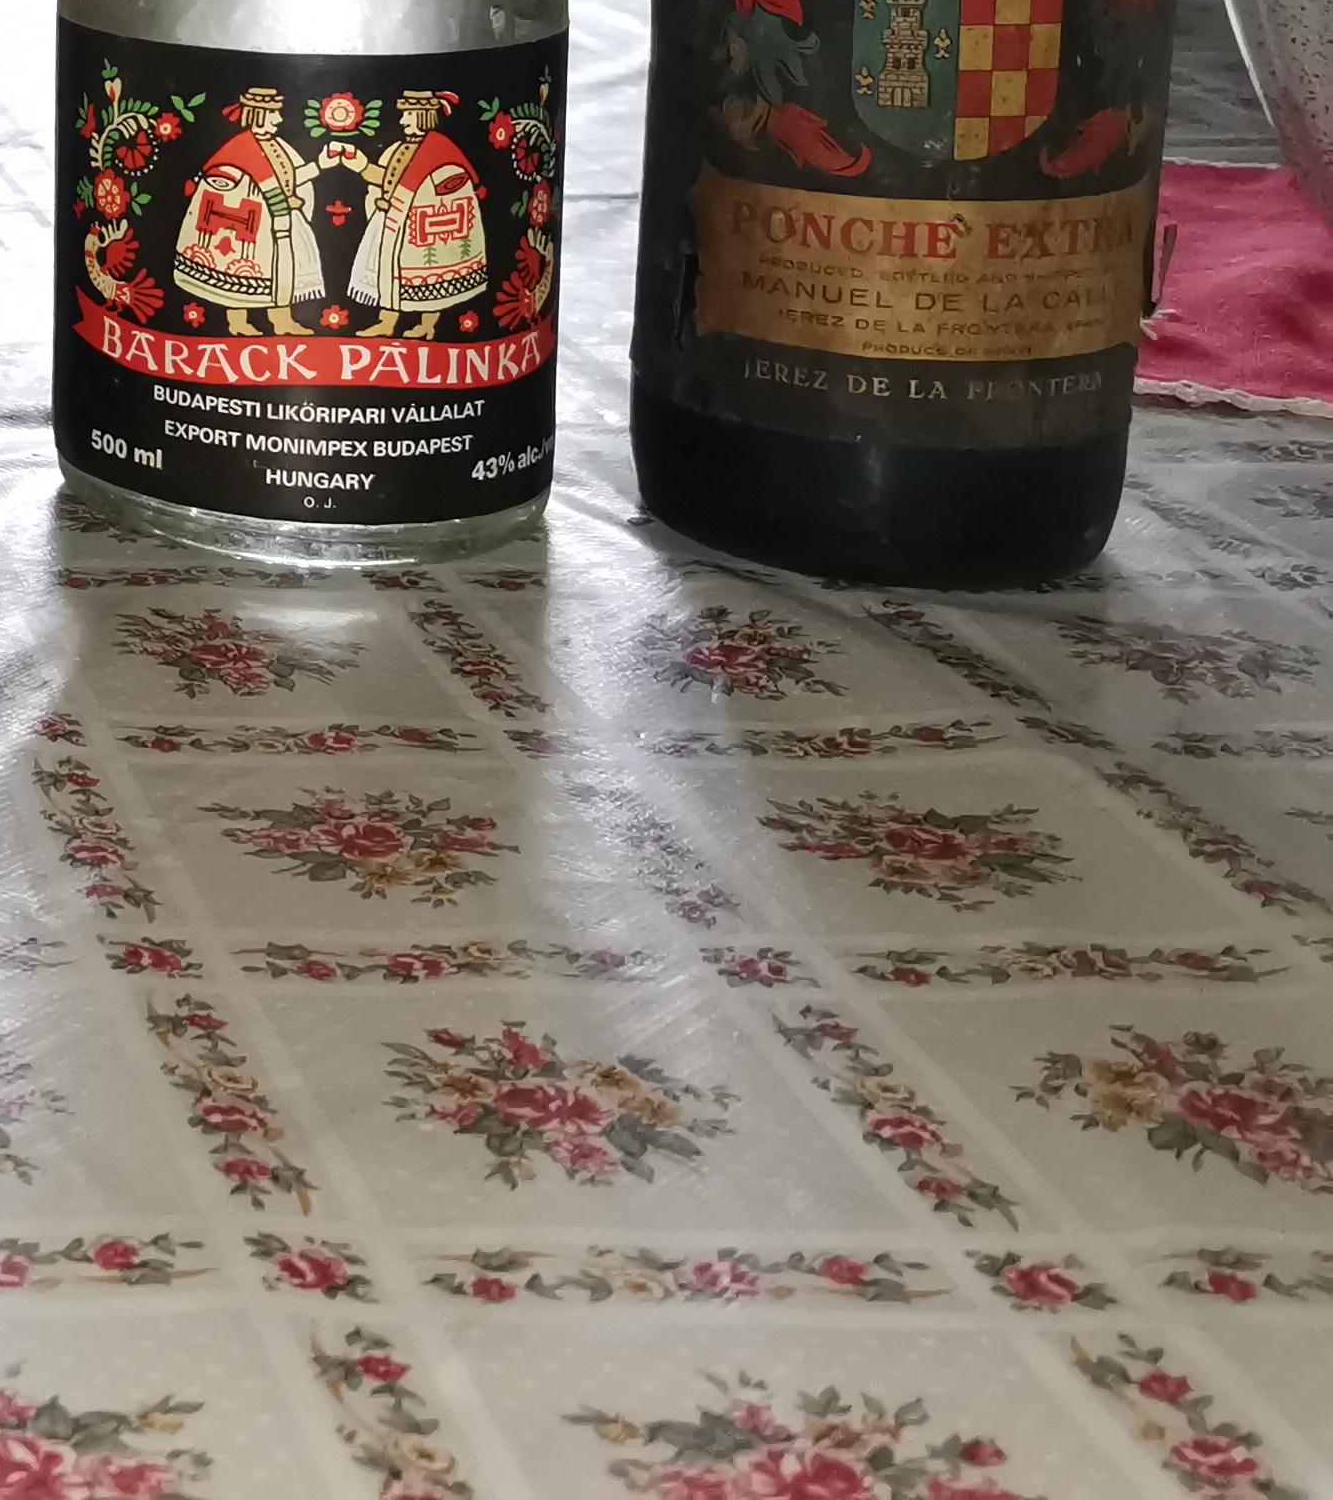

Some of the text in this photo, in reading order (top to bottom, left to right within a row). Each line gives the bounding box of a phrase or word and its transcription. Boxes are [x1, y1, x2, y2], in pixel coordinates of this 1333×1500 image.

[731, 201, 957, 260] PONCHE
[741, 271, 893, 309] MANUEL
[915, 291, 964, 313] DE
[983, 292, 1026, 313] LA
[855, 318, 886, 332] DE
[897, 320, 927, 334] LA
[102, 316, 317, 383] BARACK
[744, 356, 829, 390] JEREZ
[846, 373, 890, 396] DE
[908, 378, 949, 400] LA
[153, 384, 261, 418] BUDAPESTI
[267, 399, 386, 424] LIKÖRIPARI
[90, 428, 163, 470] 500 ml
[164, 419, 473, 457] EXPORT MONIMPEX BUDAPEST
[265, 468, 375, 491] HUNGARY
[471, 452, 515, 481] 43%
